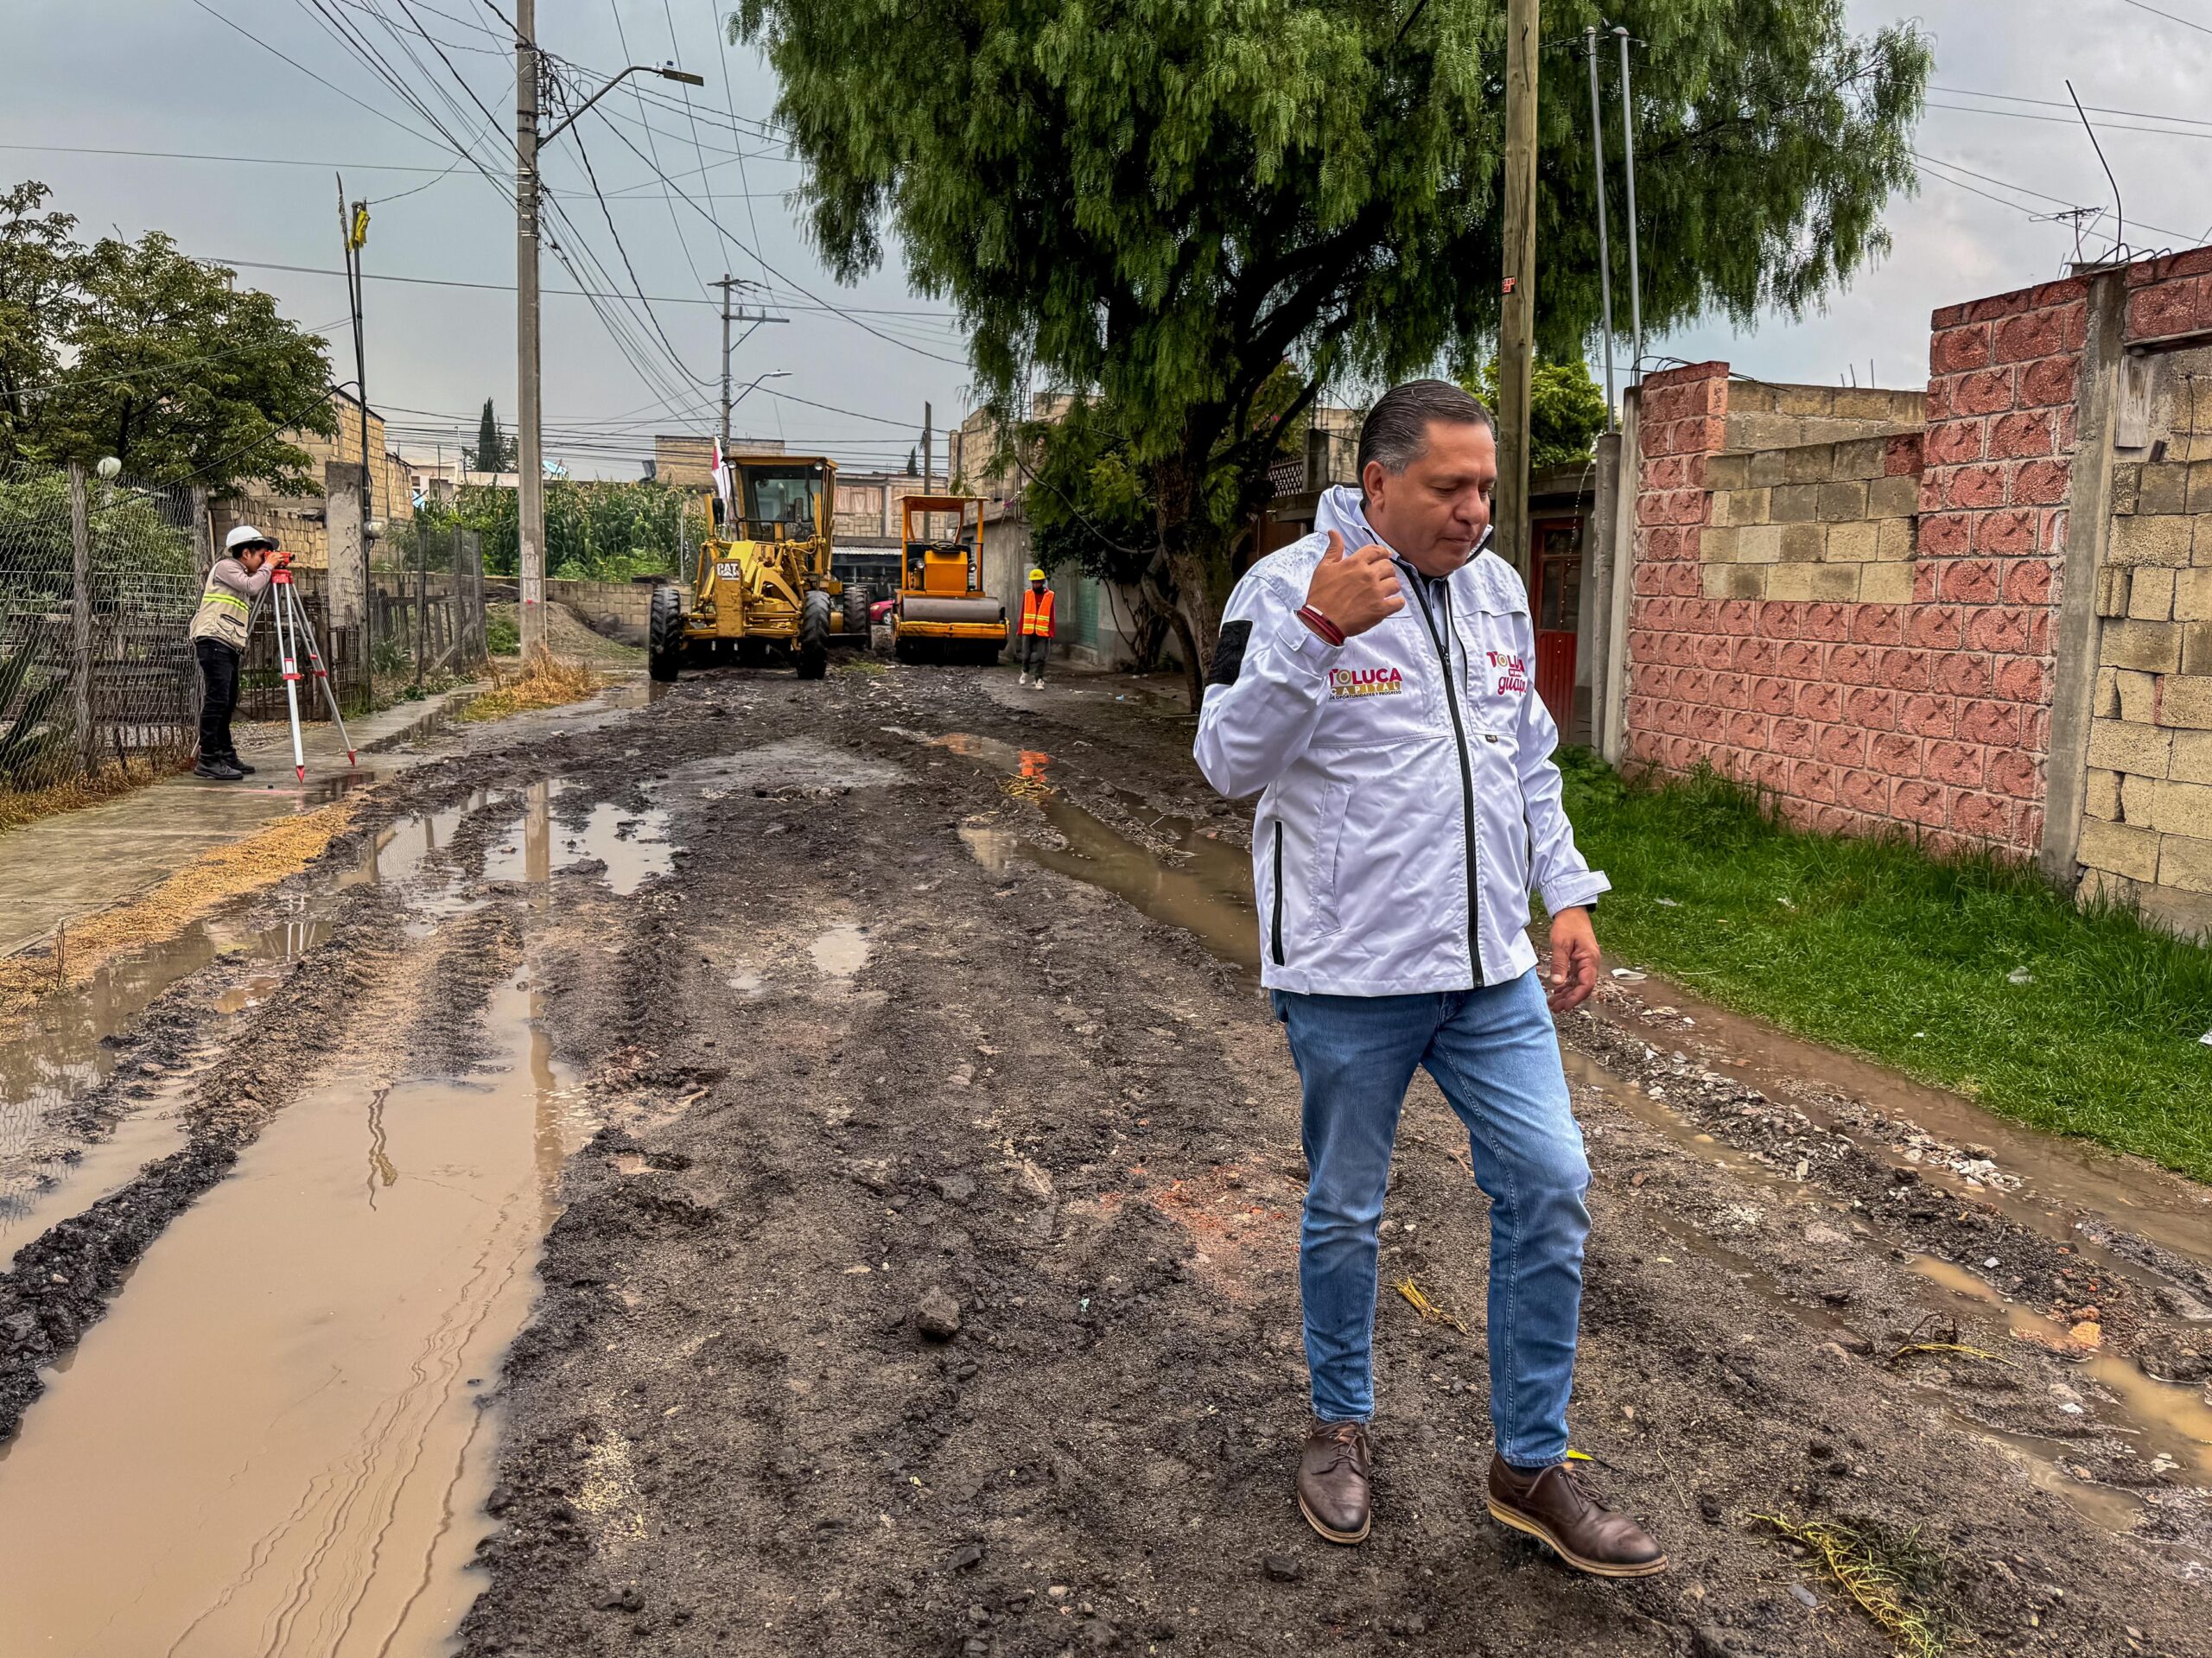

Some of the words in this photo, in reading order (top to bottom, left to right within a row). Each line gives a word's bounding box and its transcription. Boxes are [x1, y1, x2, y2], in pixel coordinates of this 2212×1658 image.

[717, 562, 739, 576] CAT
[1329, 668, 1402, 686] TOLUCA
[1331, 682, 1399, 695] CAPITAL
